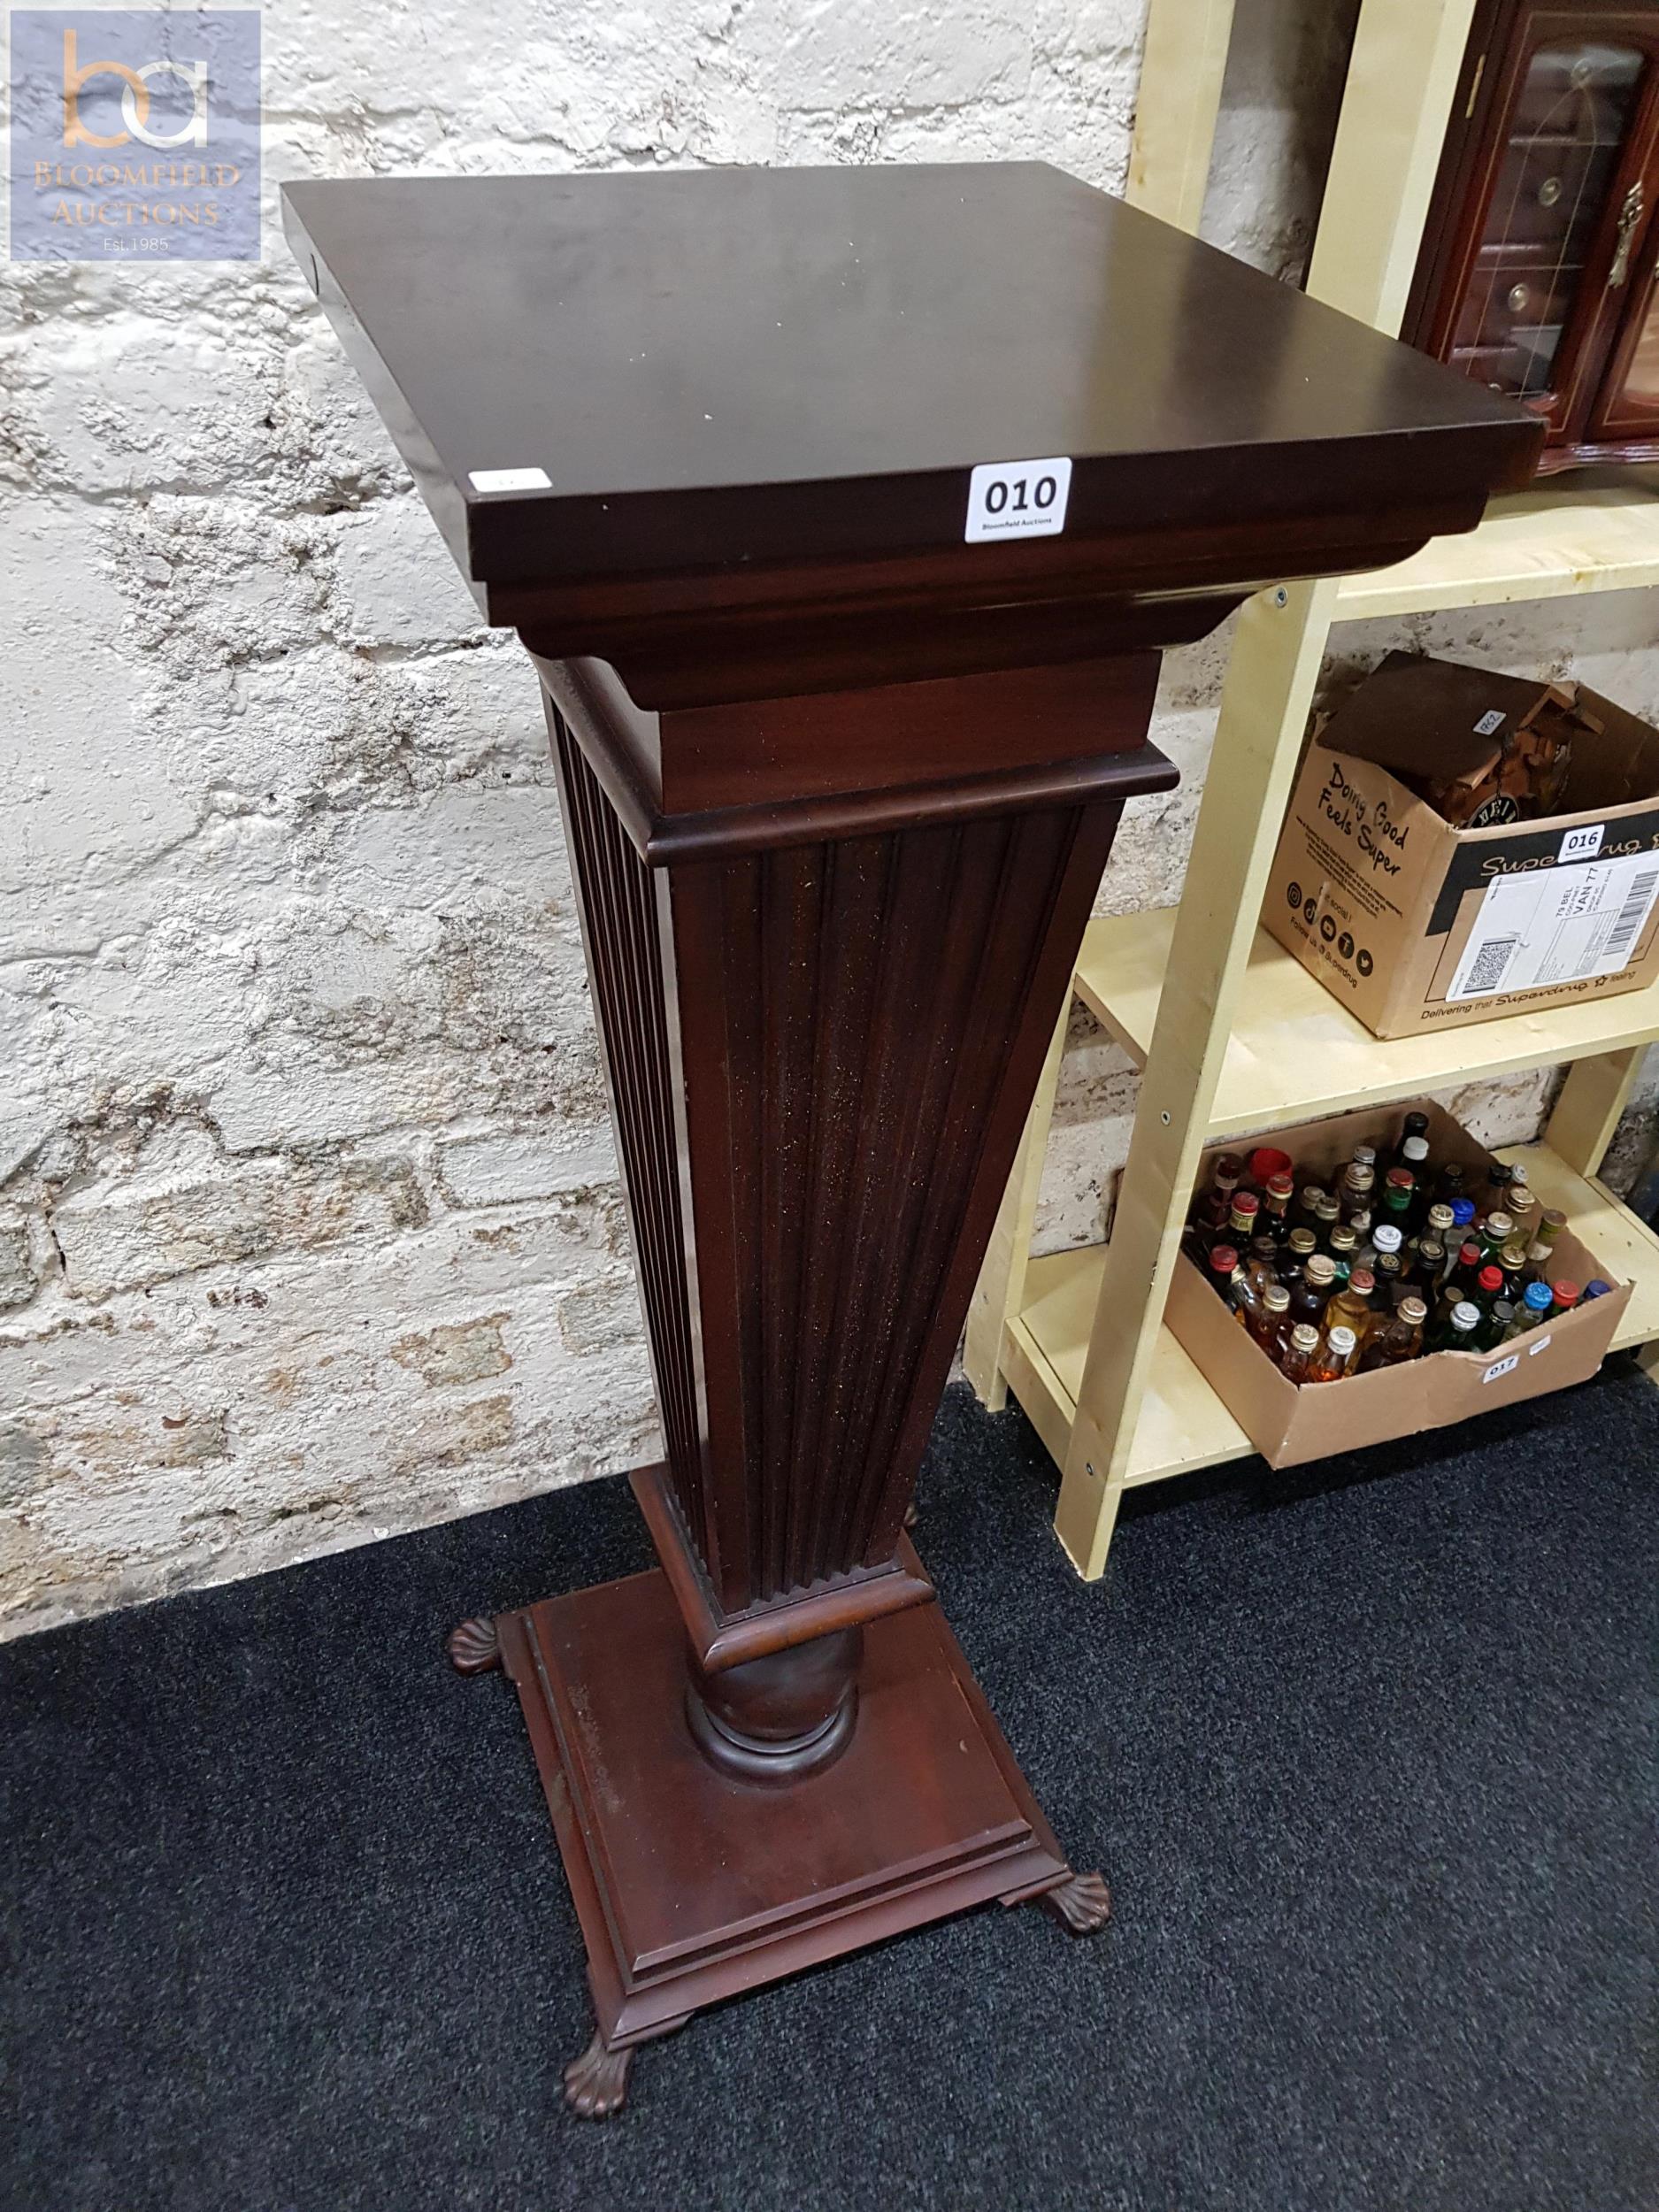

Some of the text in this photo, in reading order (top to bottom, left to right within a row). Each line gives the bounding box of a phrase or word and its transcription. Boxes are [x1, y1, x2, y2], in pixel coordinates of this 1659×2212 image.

[985, 476, 1056, 514] 010
[982, 518, 1052, 531] Bloomfield Auctions
[1329, 762, 1409, 850] Doing Good
[1317, 787, 1352, 835] Feels
[1357, 824, 1401, 876] Super
[1568, 831, 1599, 849] 016
[1480, 839, 1642, 877] Superug
[1572, 886, 1593, 915] VAN
[1586, 867, 1599, 883] 77
[1421, 1004, 1472, 1019] Delivering
[1475, 1000, 1493, 1011] that
[1495, 982, 1588, 1006] Superdrug
[1490, 1357, 1515, 1375] 017
